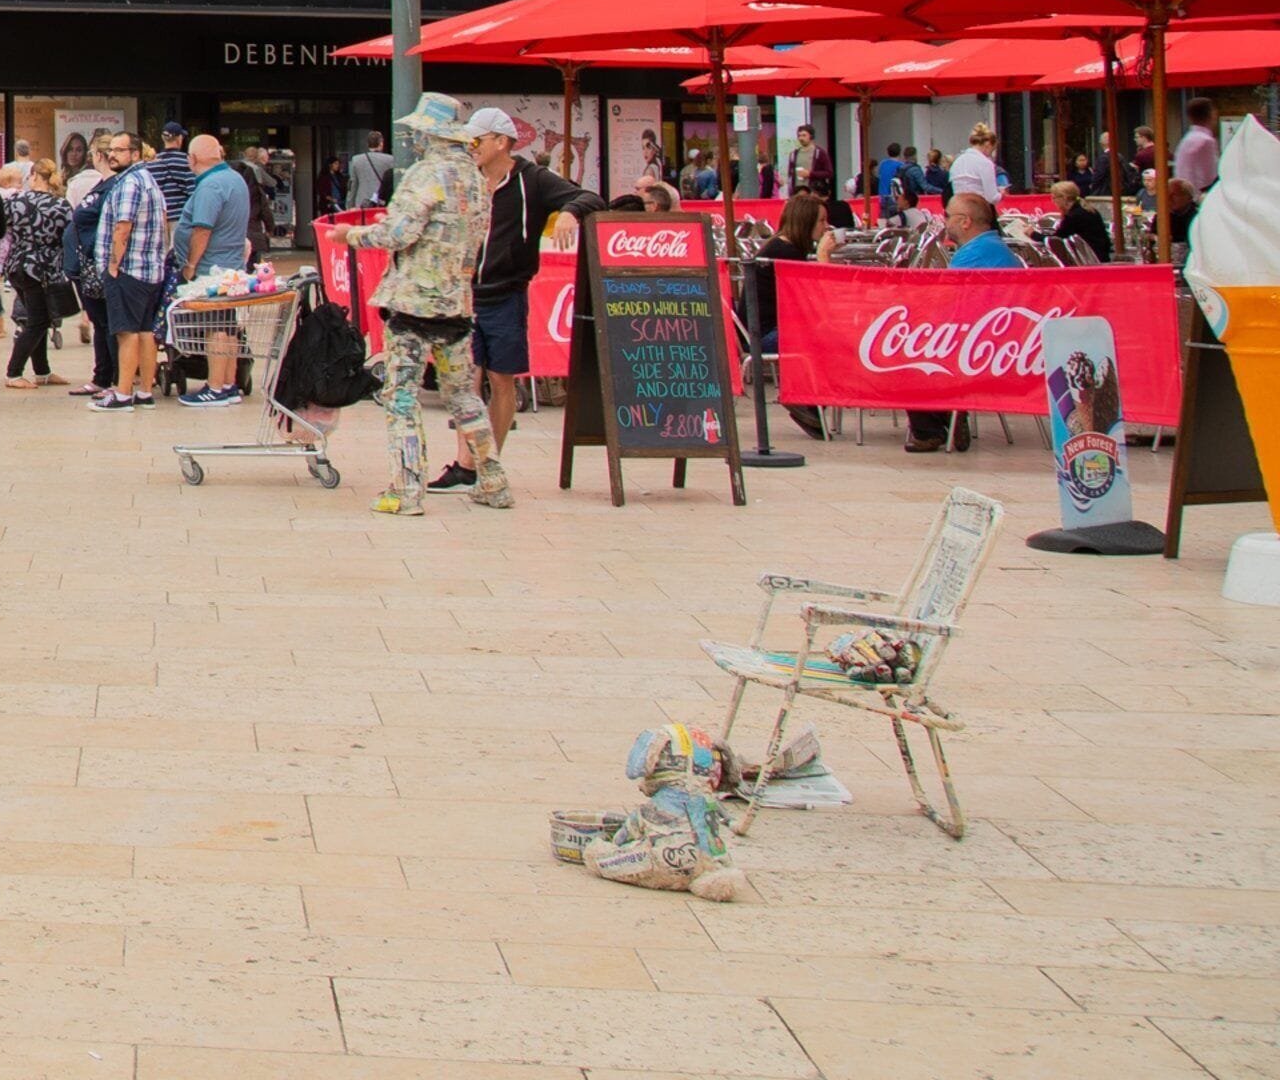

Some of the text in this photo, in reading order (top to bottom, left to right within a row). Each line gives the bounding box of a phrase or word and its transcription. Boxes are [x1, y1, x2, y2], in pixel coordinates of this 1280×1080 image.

[224, 43, 387, 66] DEBENHAM
[607, 230, 691, 258] Coca-Cola
[656, 278, 706, 295] SPECIAL
[606, 301, 711, 317] BREADED WHOLE TAIL
[630, 318, 699, 342] SCAMPI
[858, 305, 1077, 377] Coca-Col
[622, 345, 707, 362] WITH FRIES
[631, 362, 709, 379] SIDE SALAD
[636, 381, 721, 398] AND COLESLAW
[617, 402, 664, 427] ONLY
[1066, 435, 1114, 456] New Forest
